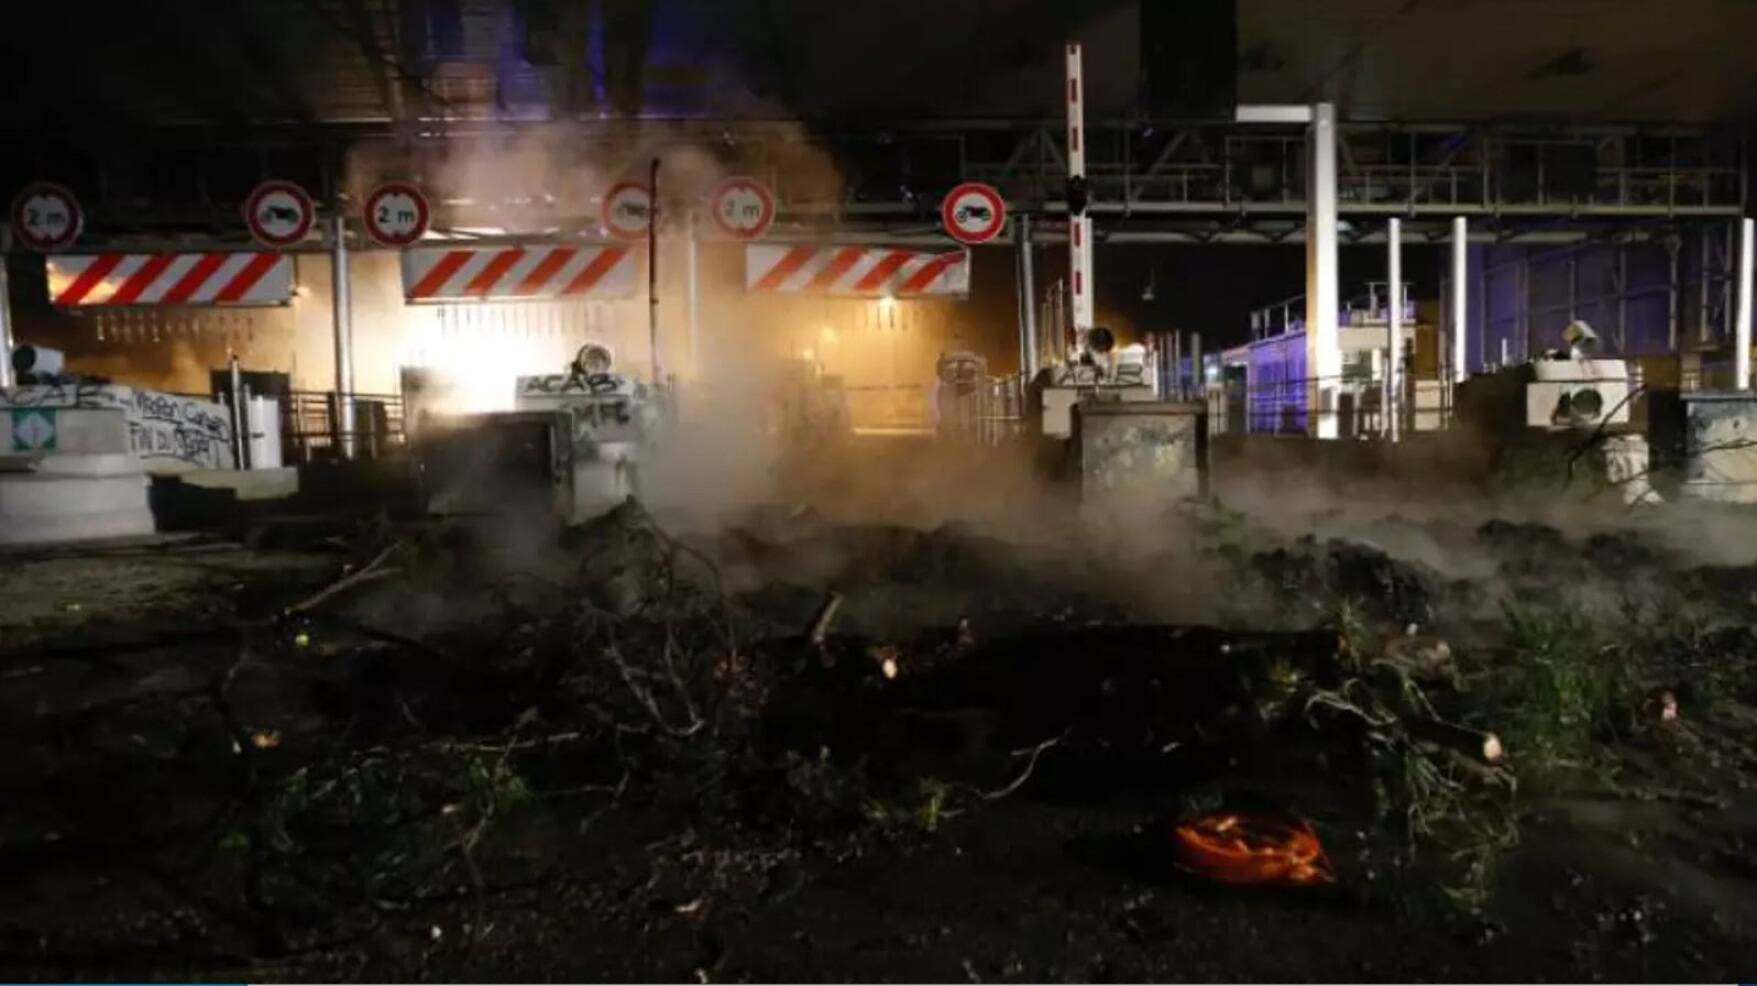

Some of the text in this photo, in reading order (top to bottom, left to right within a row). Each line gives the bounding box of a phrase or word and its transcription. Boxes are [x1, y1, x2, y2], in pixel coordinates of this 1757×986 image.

[28, 208, 67, 226] 2 m
[378, 205, 416, 224] 2 m
[724, 199, 760, 218] 2 m
[523, 373, 618, 393] ACAB
